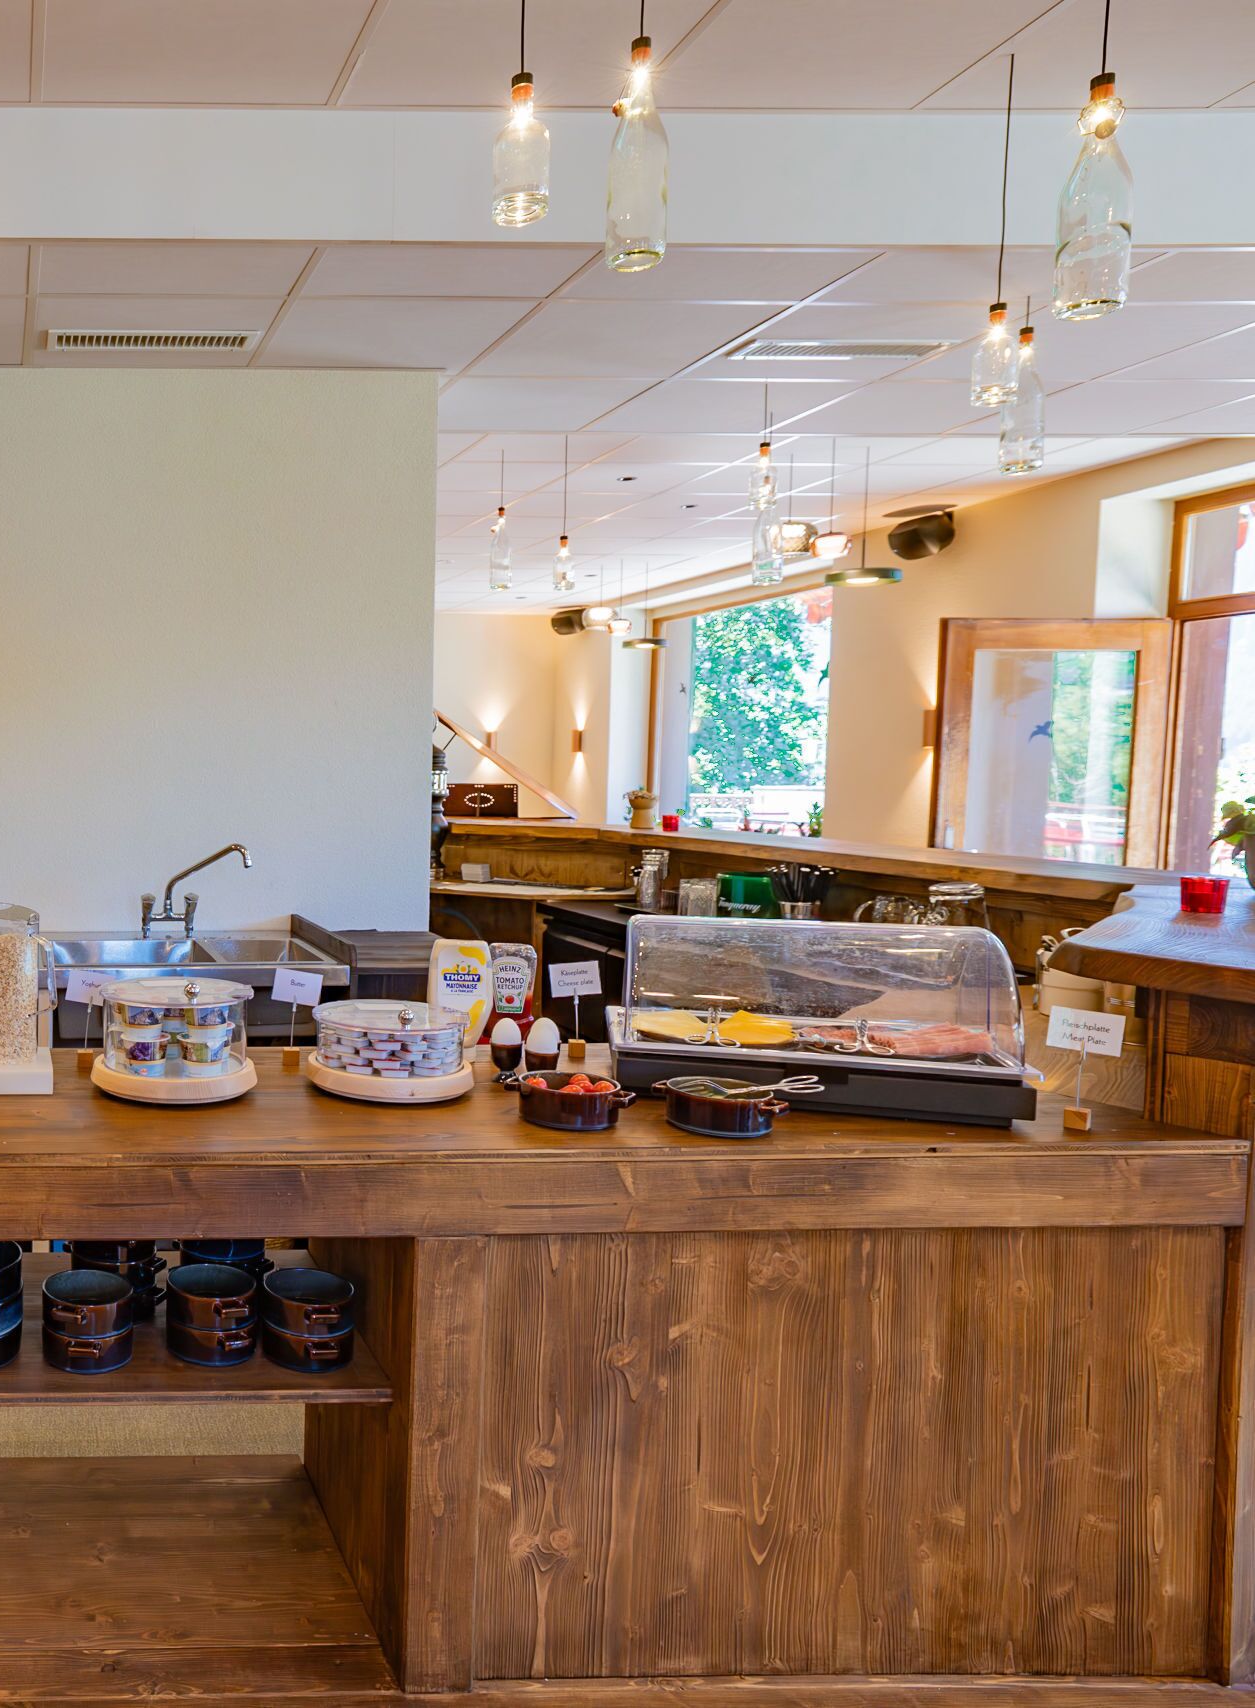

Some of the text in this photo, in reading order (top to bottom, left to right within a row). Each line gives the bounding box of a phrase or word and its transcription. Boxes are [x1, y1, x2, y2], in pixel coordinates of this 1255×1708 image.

[719, 896, 761, 914] Tanqueray
[499, 964, 522, 974] HEINZ
[81, 979, 102, 989] Yoghur
[496, 976, 525, 984] TOMATO
[1061, 1018, 1111, 1034] Fleischplatte
[1087, 1035, 1108, 1046] Plate
